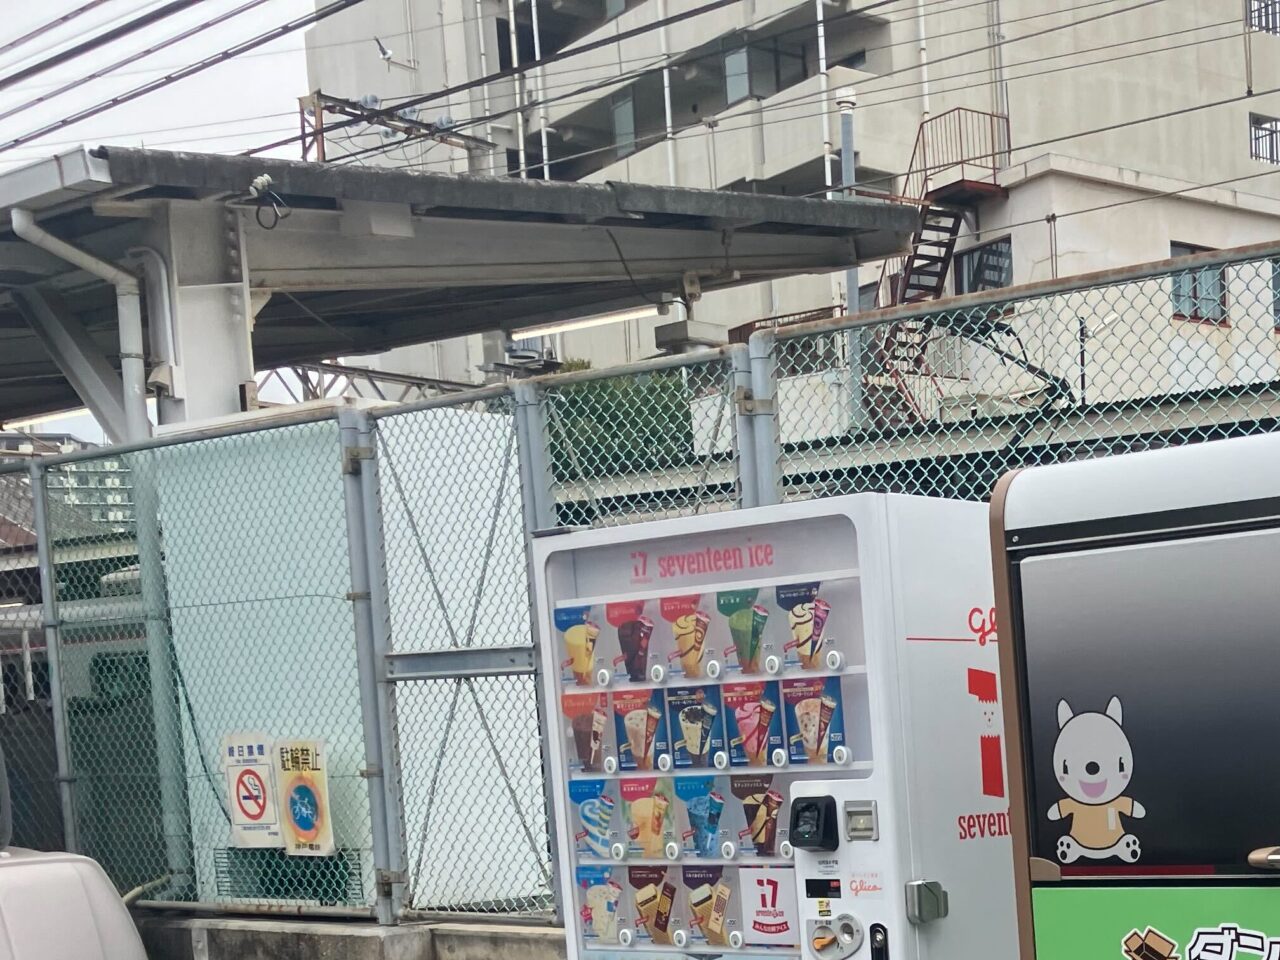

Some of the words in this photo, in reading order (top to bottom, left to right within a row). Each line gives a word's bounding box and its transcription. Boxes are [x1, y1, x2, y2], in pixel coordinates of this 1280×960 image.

[657, 546, 743, 578] seventeen
[748, 537, 774, 568] ice
[280, 746, 321, 771] 駐輪禁止
[850, 879, 882, 896] Glico
